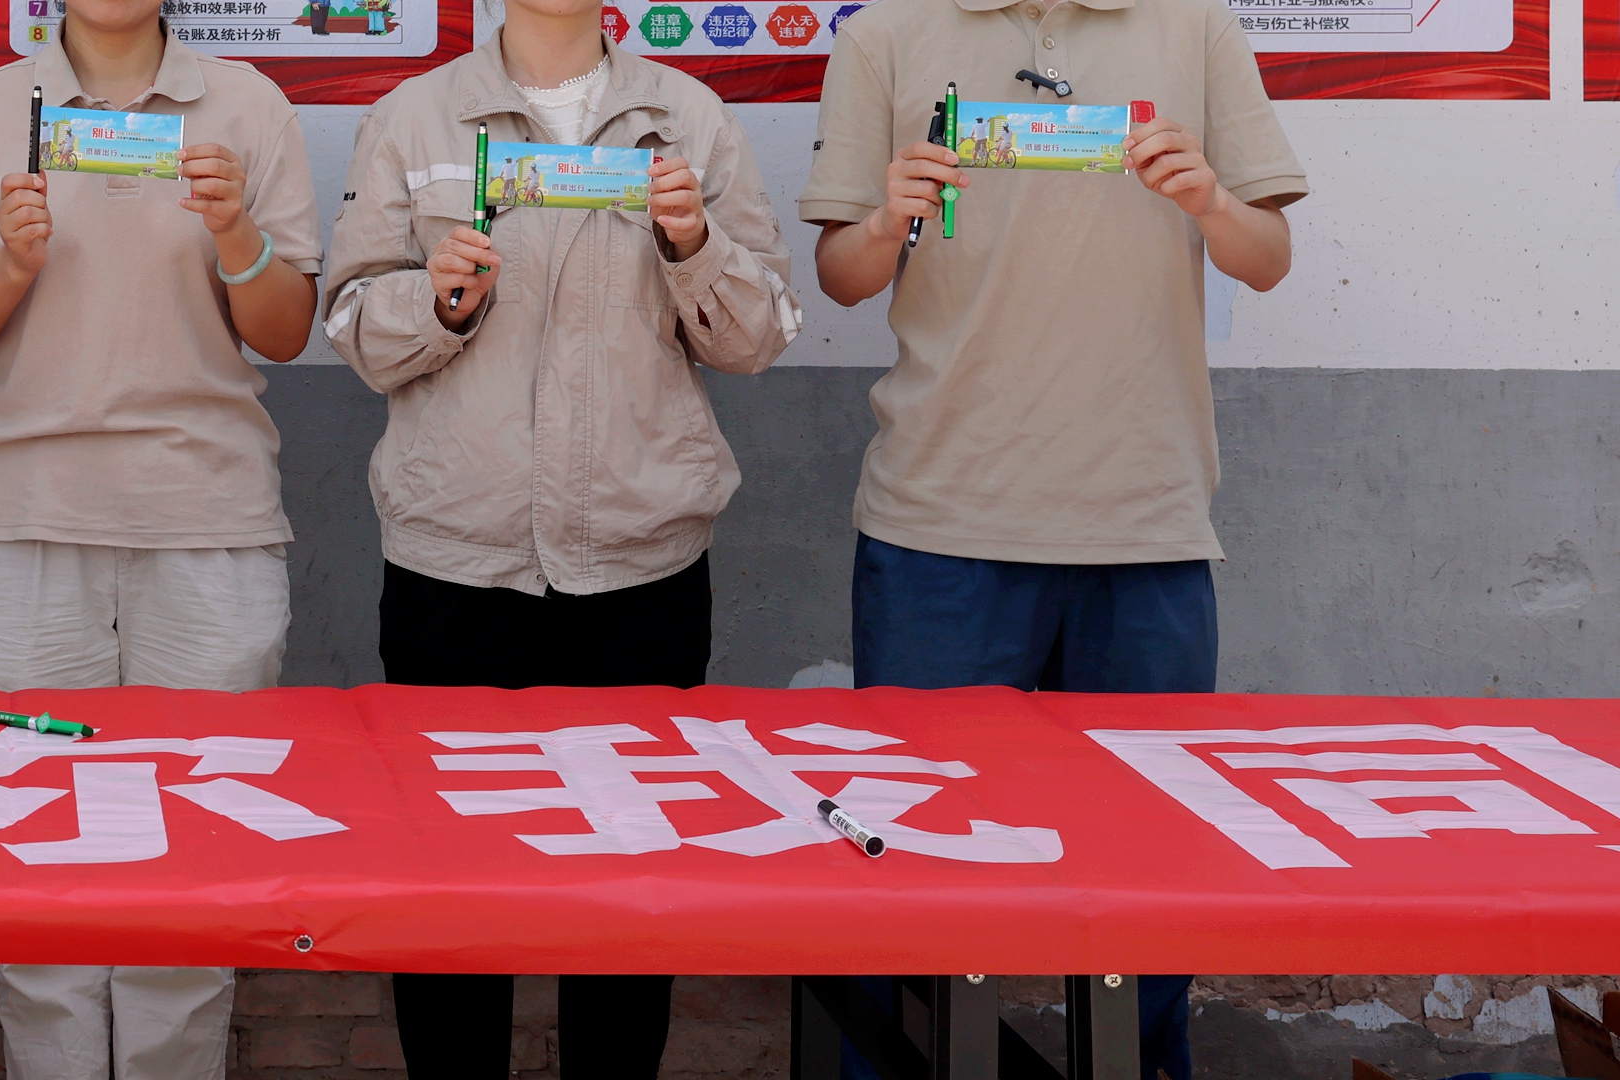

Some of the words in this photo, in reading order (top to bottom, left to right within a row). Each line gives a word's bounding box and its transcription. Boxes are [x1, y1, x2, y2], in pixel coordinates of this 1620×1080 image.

[33, 2, 42, 14] 7
[651, 14, 681, 26] 违章
[709, 15, 749, 26] 违反劳
[772, 16, 813, 26] 个人无
[33, 28, 42, 40] 8
[651, 26, 681, 39] 指挥
[709, 27, 749, 37] 动纪律
[779, 27, 806, 38] 违章
[92, 127, 114, 139] 别让
[1031, 122, 1056, 134] 别让
[558, 162, 581, 174] 别让
